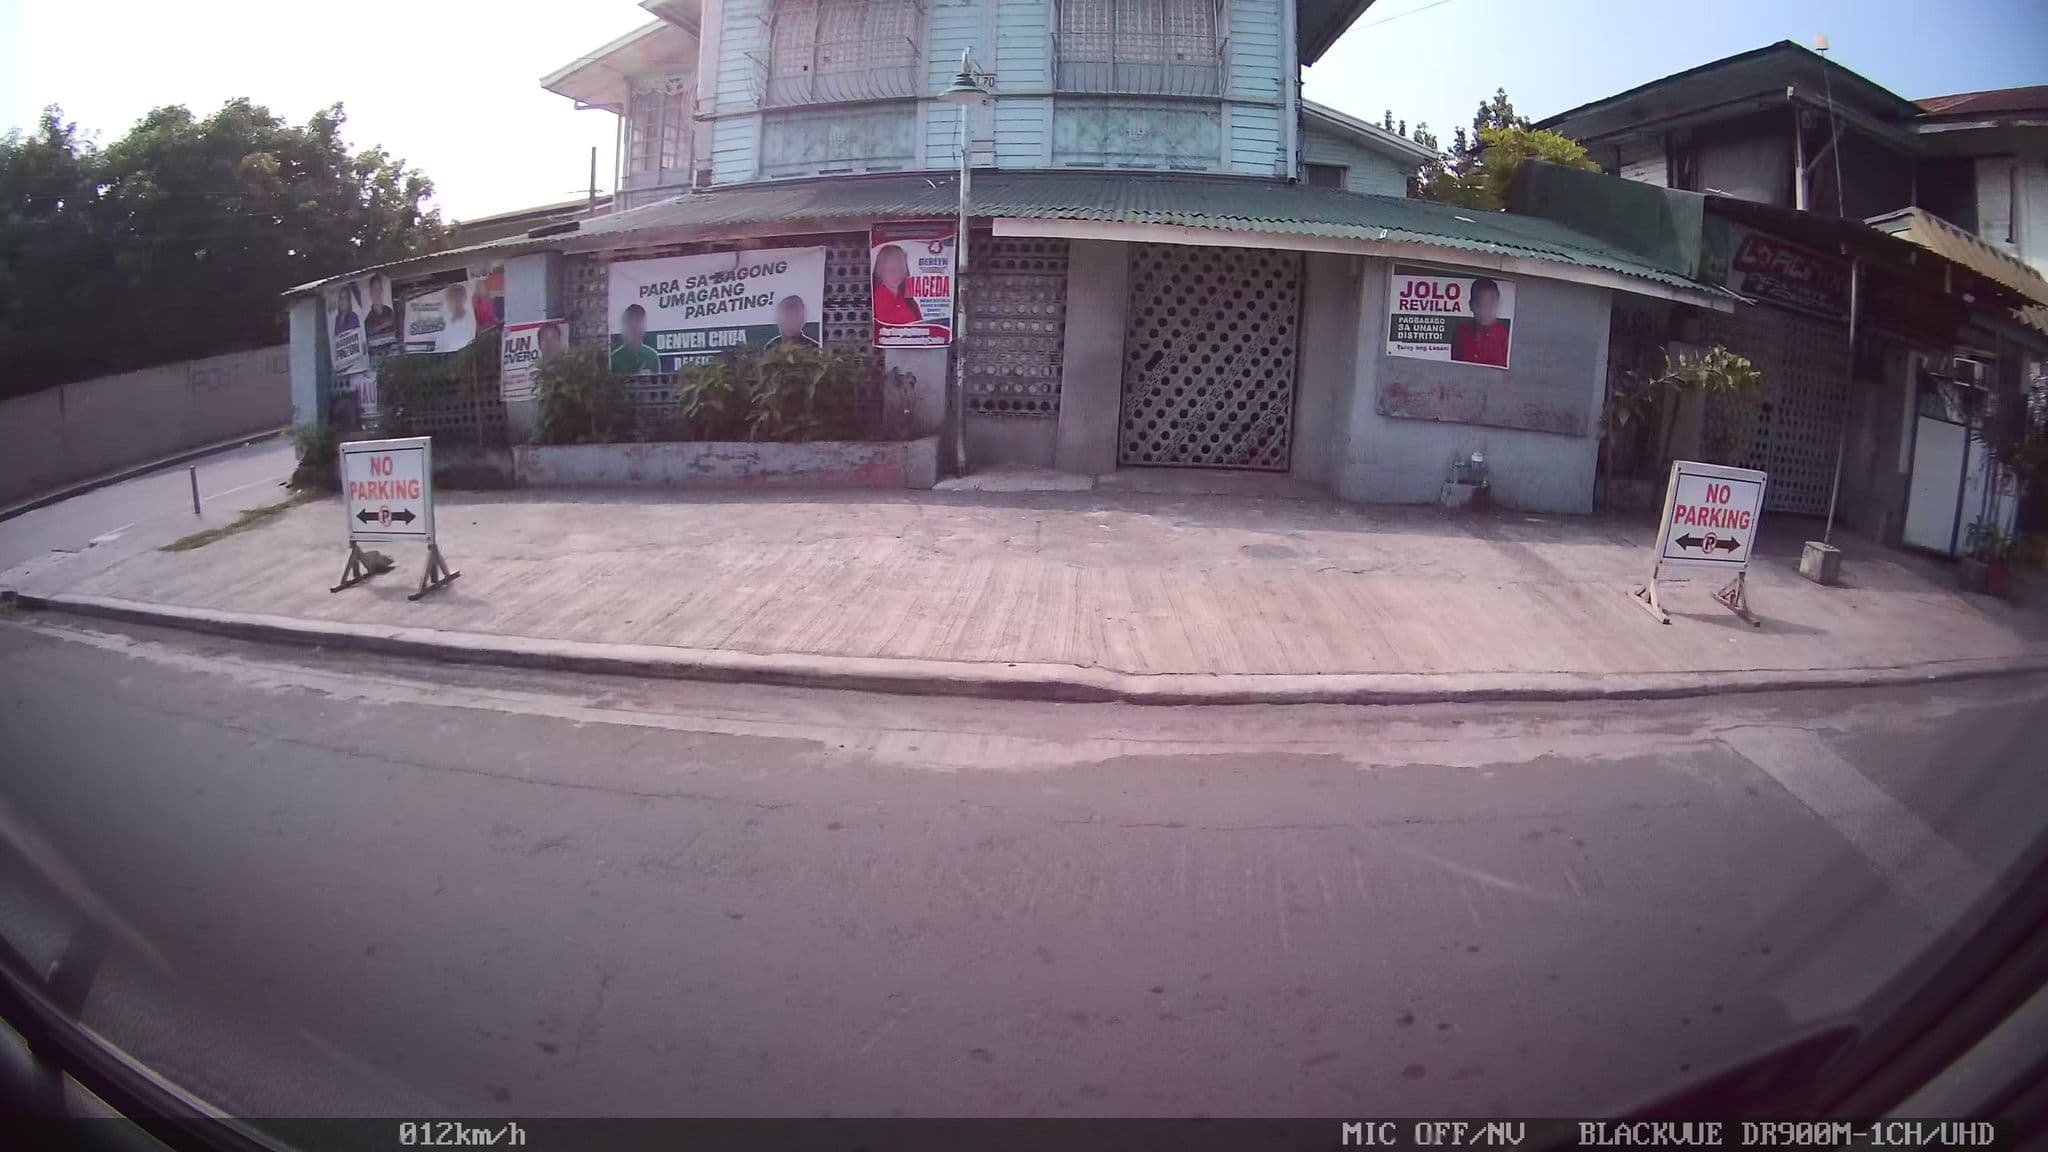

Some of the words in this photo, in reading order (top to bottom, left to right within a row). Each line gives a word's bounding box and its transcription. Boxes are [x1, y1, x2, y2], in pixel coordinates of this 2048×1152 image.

[640, 279, 680, 298] PARA
[685, 274, 708, 290] SA
[710, 261, 788, 284] BAGONG
[904, 275, 950, 298] MACEDA
[659, 282, 745, 309] UMAGANG
[1399, 281, 1461, 300] JOLO
[685, 291, 775, 320] PARATING!
[1399, 299, 1461, 312] REVILLA
[1398, 323, 1410, 331] SA
[1413, 324, 1445, 332] UNANG
[656, 332, 706, 350] DENVER
[709, 329, 747, 347] CHUA
[370, 456, 393, 477] NO
[349, 479, 420, 500] PARKING
[1706, 483, 1731, 505] NO
[1673, 504, 1750, 530] PARKING
